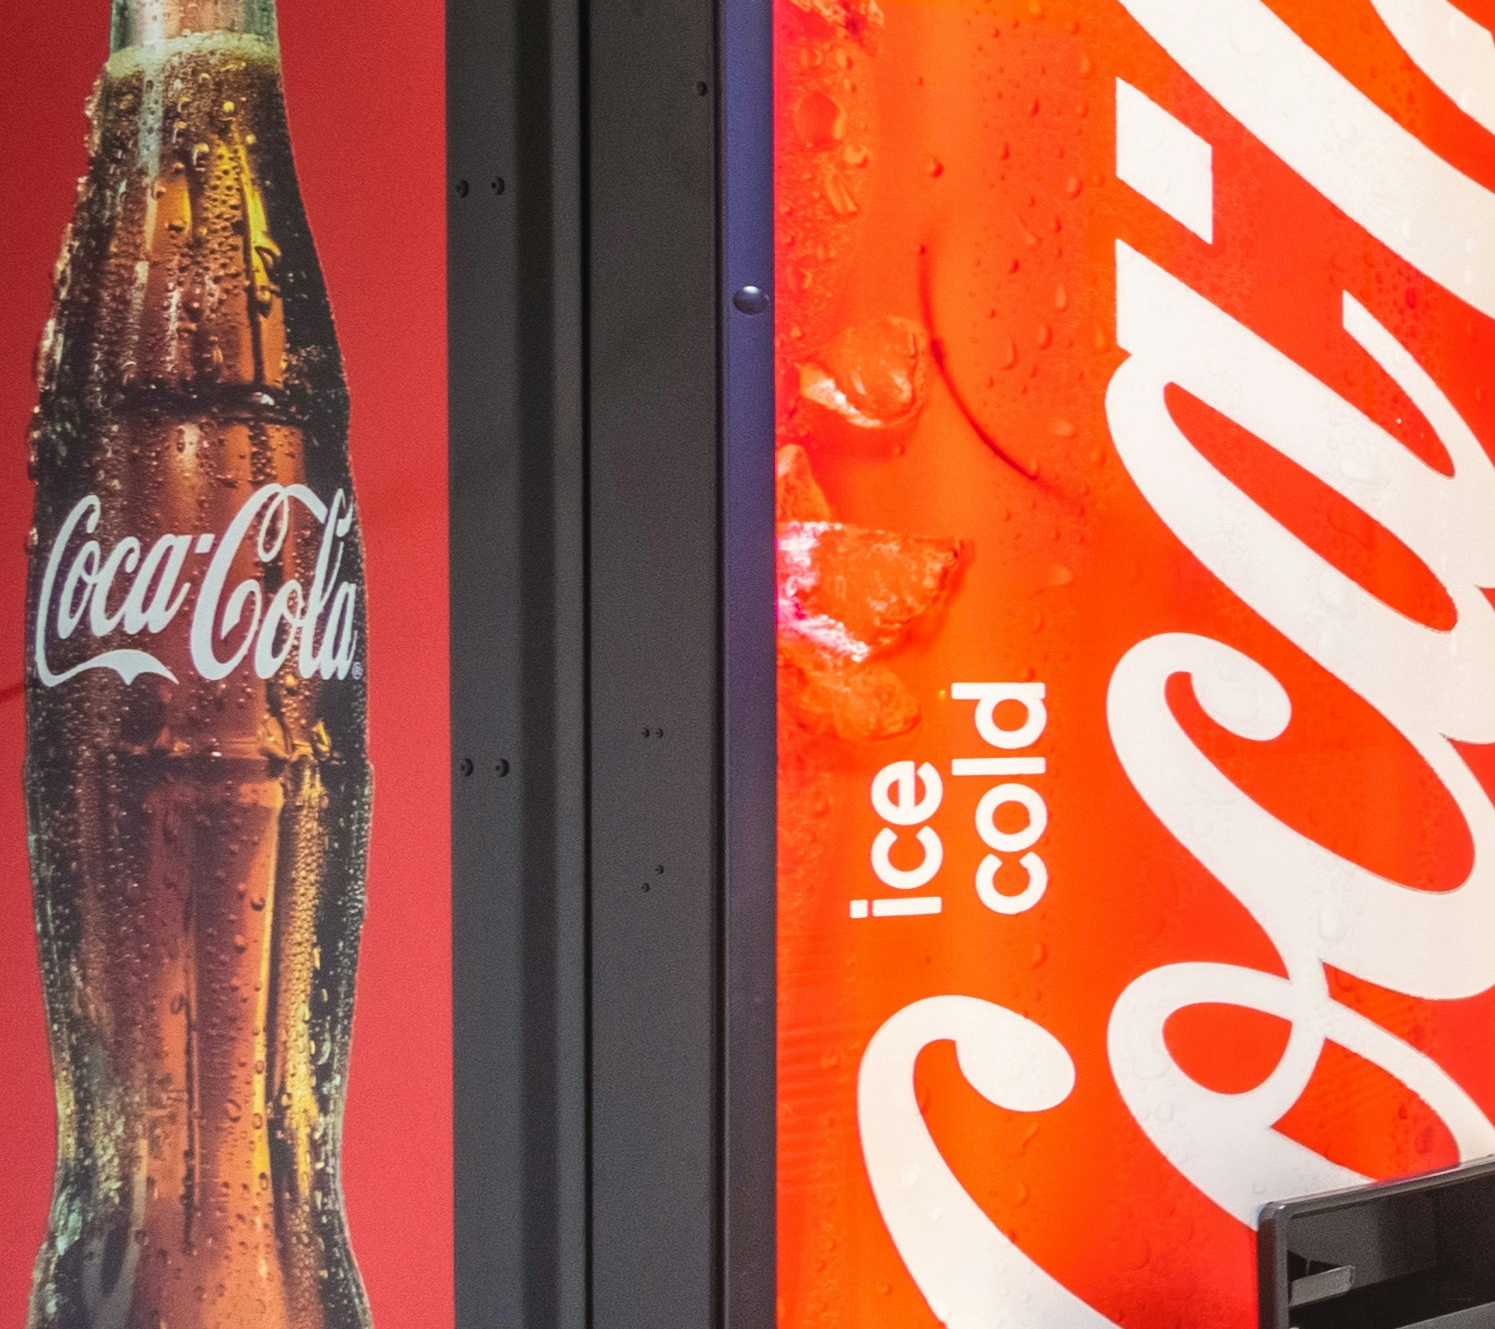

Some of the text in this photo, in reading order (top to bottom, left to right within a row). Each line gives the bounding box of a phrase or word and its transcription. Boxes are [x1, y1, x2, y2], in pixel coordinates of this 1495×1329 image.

[35, 483, 359, 687] Coca-Cola
[850, 760, 944, 919] ice
[952, 682, 1047, 915] cold
